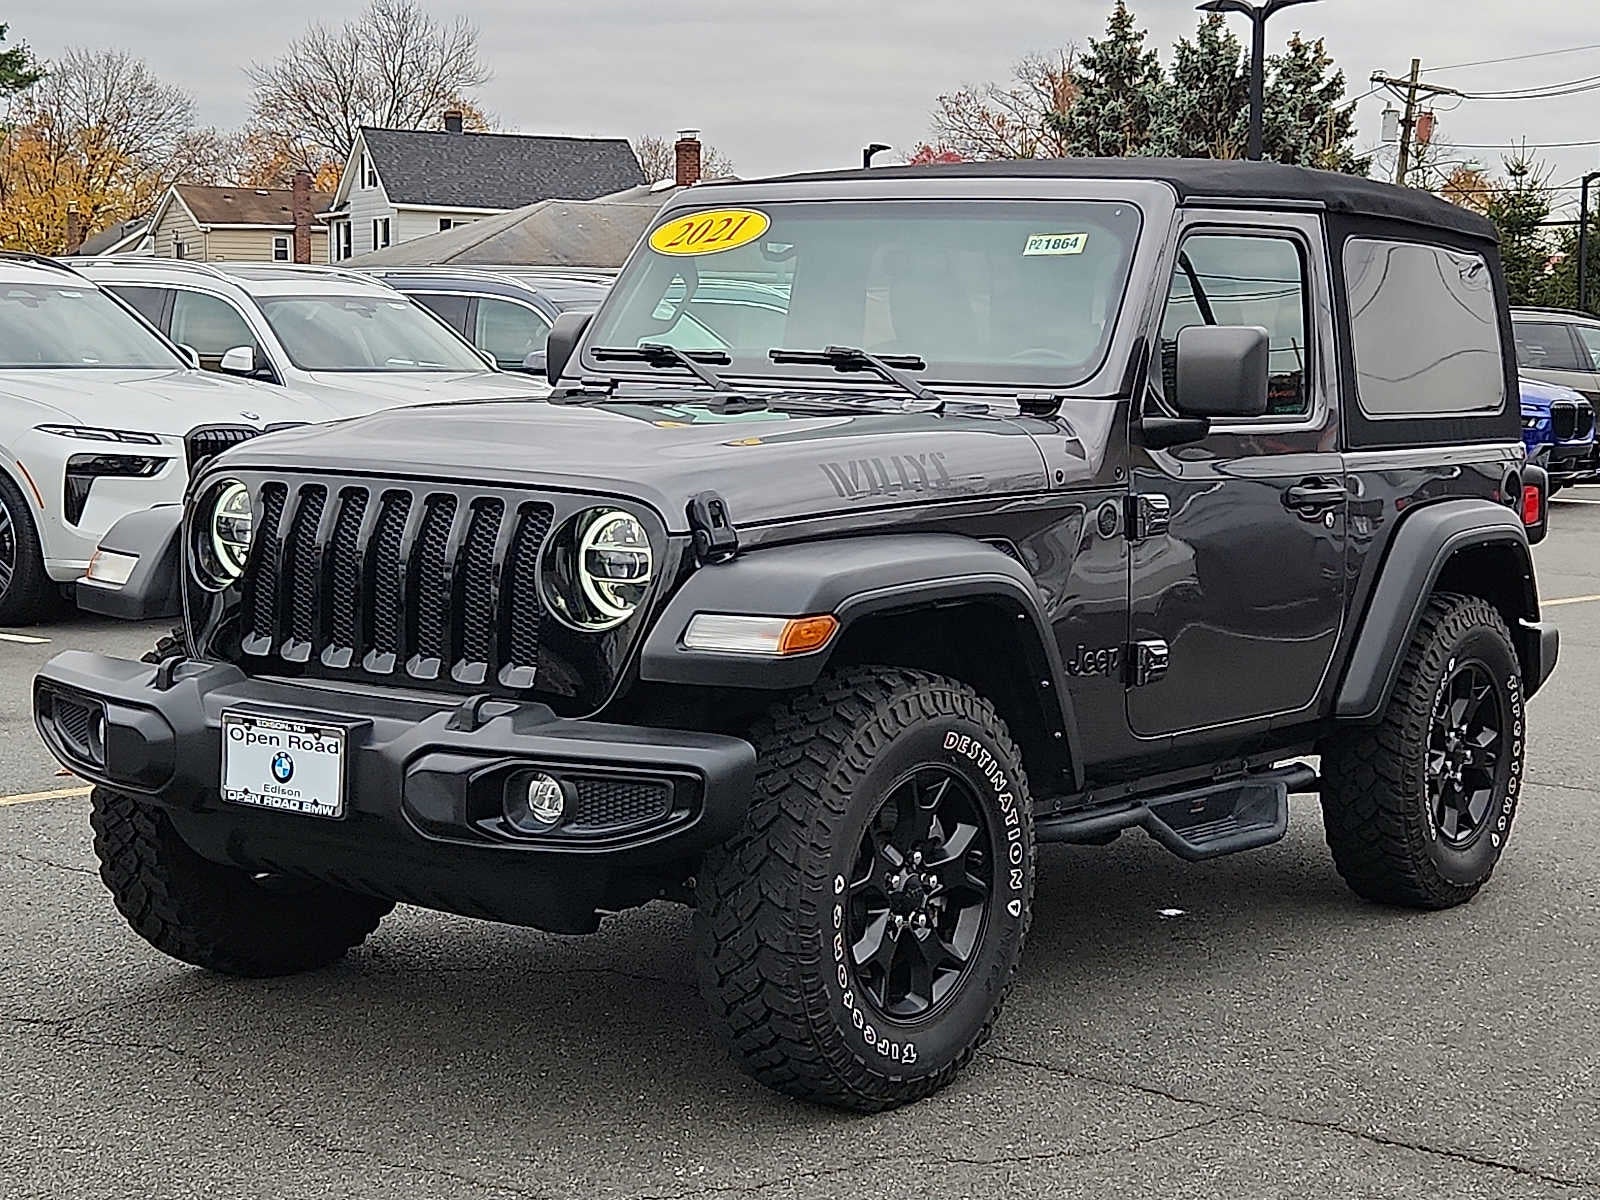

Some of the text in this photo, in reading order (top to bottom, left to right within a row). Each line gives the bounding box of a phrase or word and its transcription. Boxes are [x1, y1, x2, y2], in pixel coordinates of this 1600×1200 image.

[664, 214, 753, 248] 2021
[818, 452, 951, 499] WILLYS
[1065, 643, 1119, 677] Jeep
[230, 727, 339, 755] Open Road
[228, 791, 333, 815] OPEN ROAD BMW
[263, 783, 301, 798] Edison
[943, 731, 1023, 889] DESTINATION
